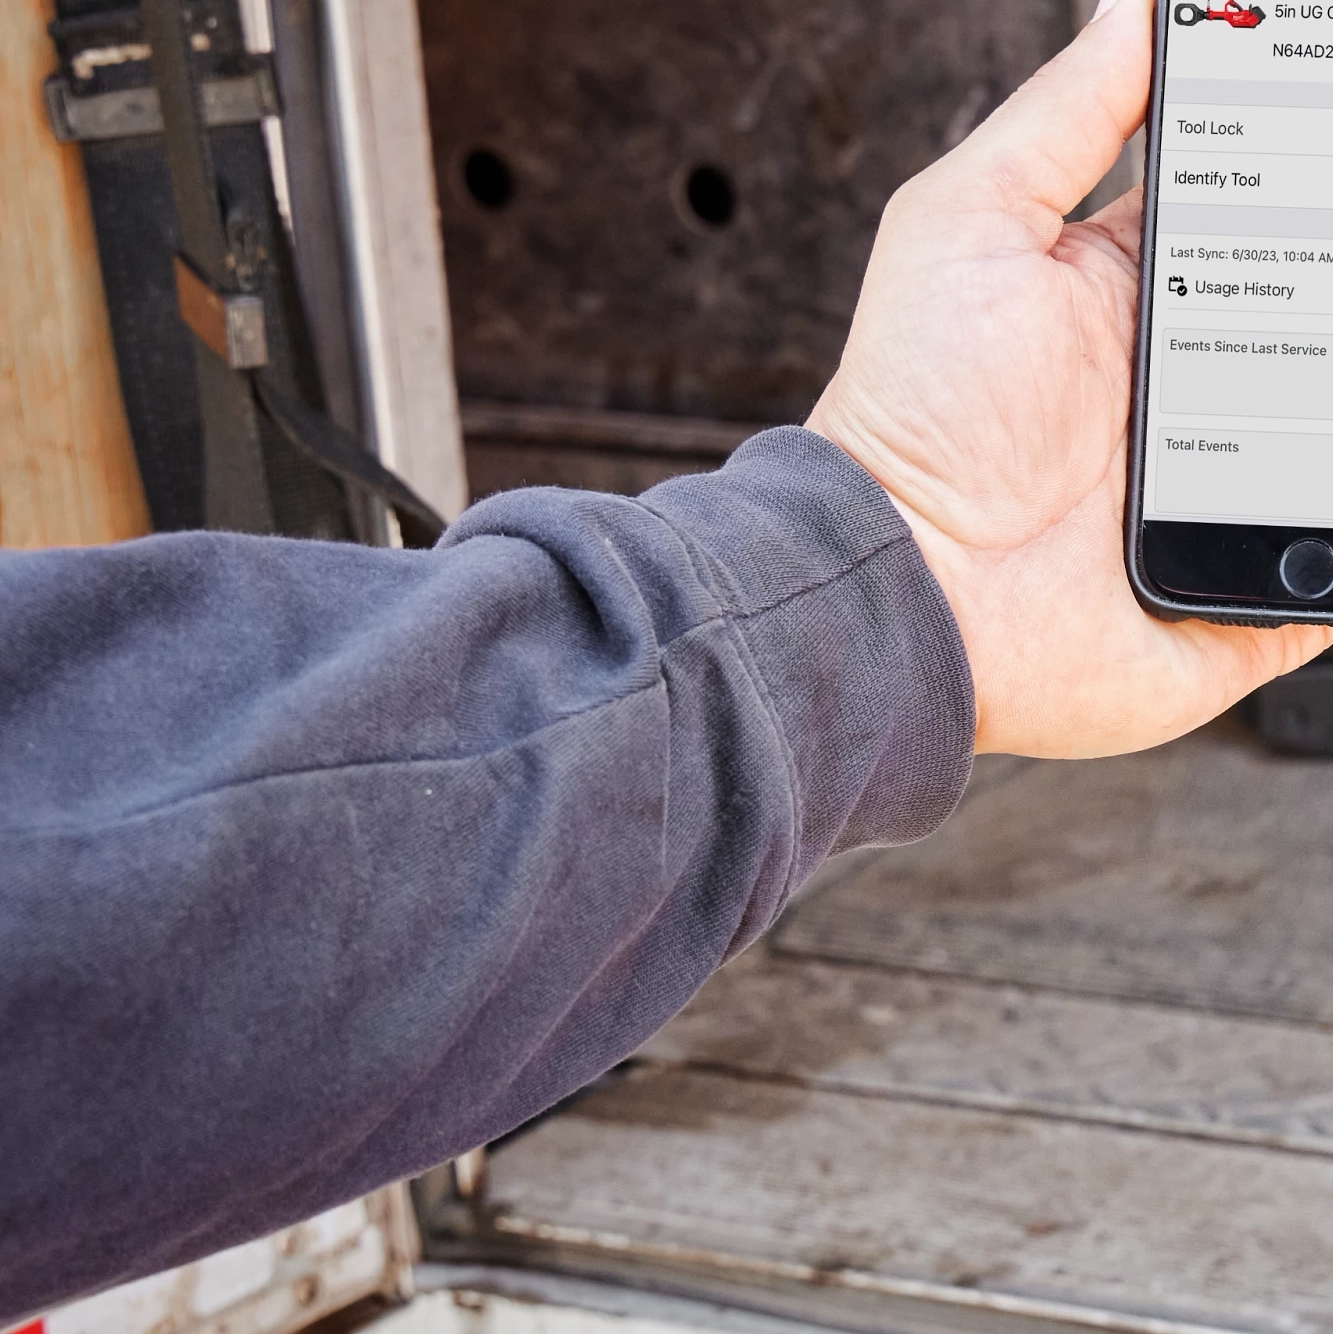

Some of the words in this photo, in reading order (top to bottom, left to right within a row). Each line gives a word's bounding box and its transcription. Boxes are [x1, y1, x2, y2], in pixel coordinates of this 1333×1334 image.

[1274, 3, 1296, 19] 5in
[1300, 4, 1323, 20] UG
[1176, 119, 1206, 135] Tool
[1210, 121, 1244, 136] Lock
[1174, 170, 1228, 189] Identify
[1231, 172, 1261, 187] Tool
[1170, 246, 1195, 259] Last
[1197, 247, 1229, 262] Sync:
[1231, 248, 1279, 264] 6/30/23,
[1282, 250, 1315, 263] 10:04
[1195, 279, 1240, 298] Usage
[1244, 281, 1295, 300] History
[1169, 338, 1211, 352] Events
[1214, 340, 1248, 354] Since
[1251, 341, 1278, 355] Last
[1280, 343, 1327, 357] Service
[1164, 438, 1195, 451] Total
[1198, 439, 1240, 453] Events
